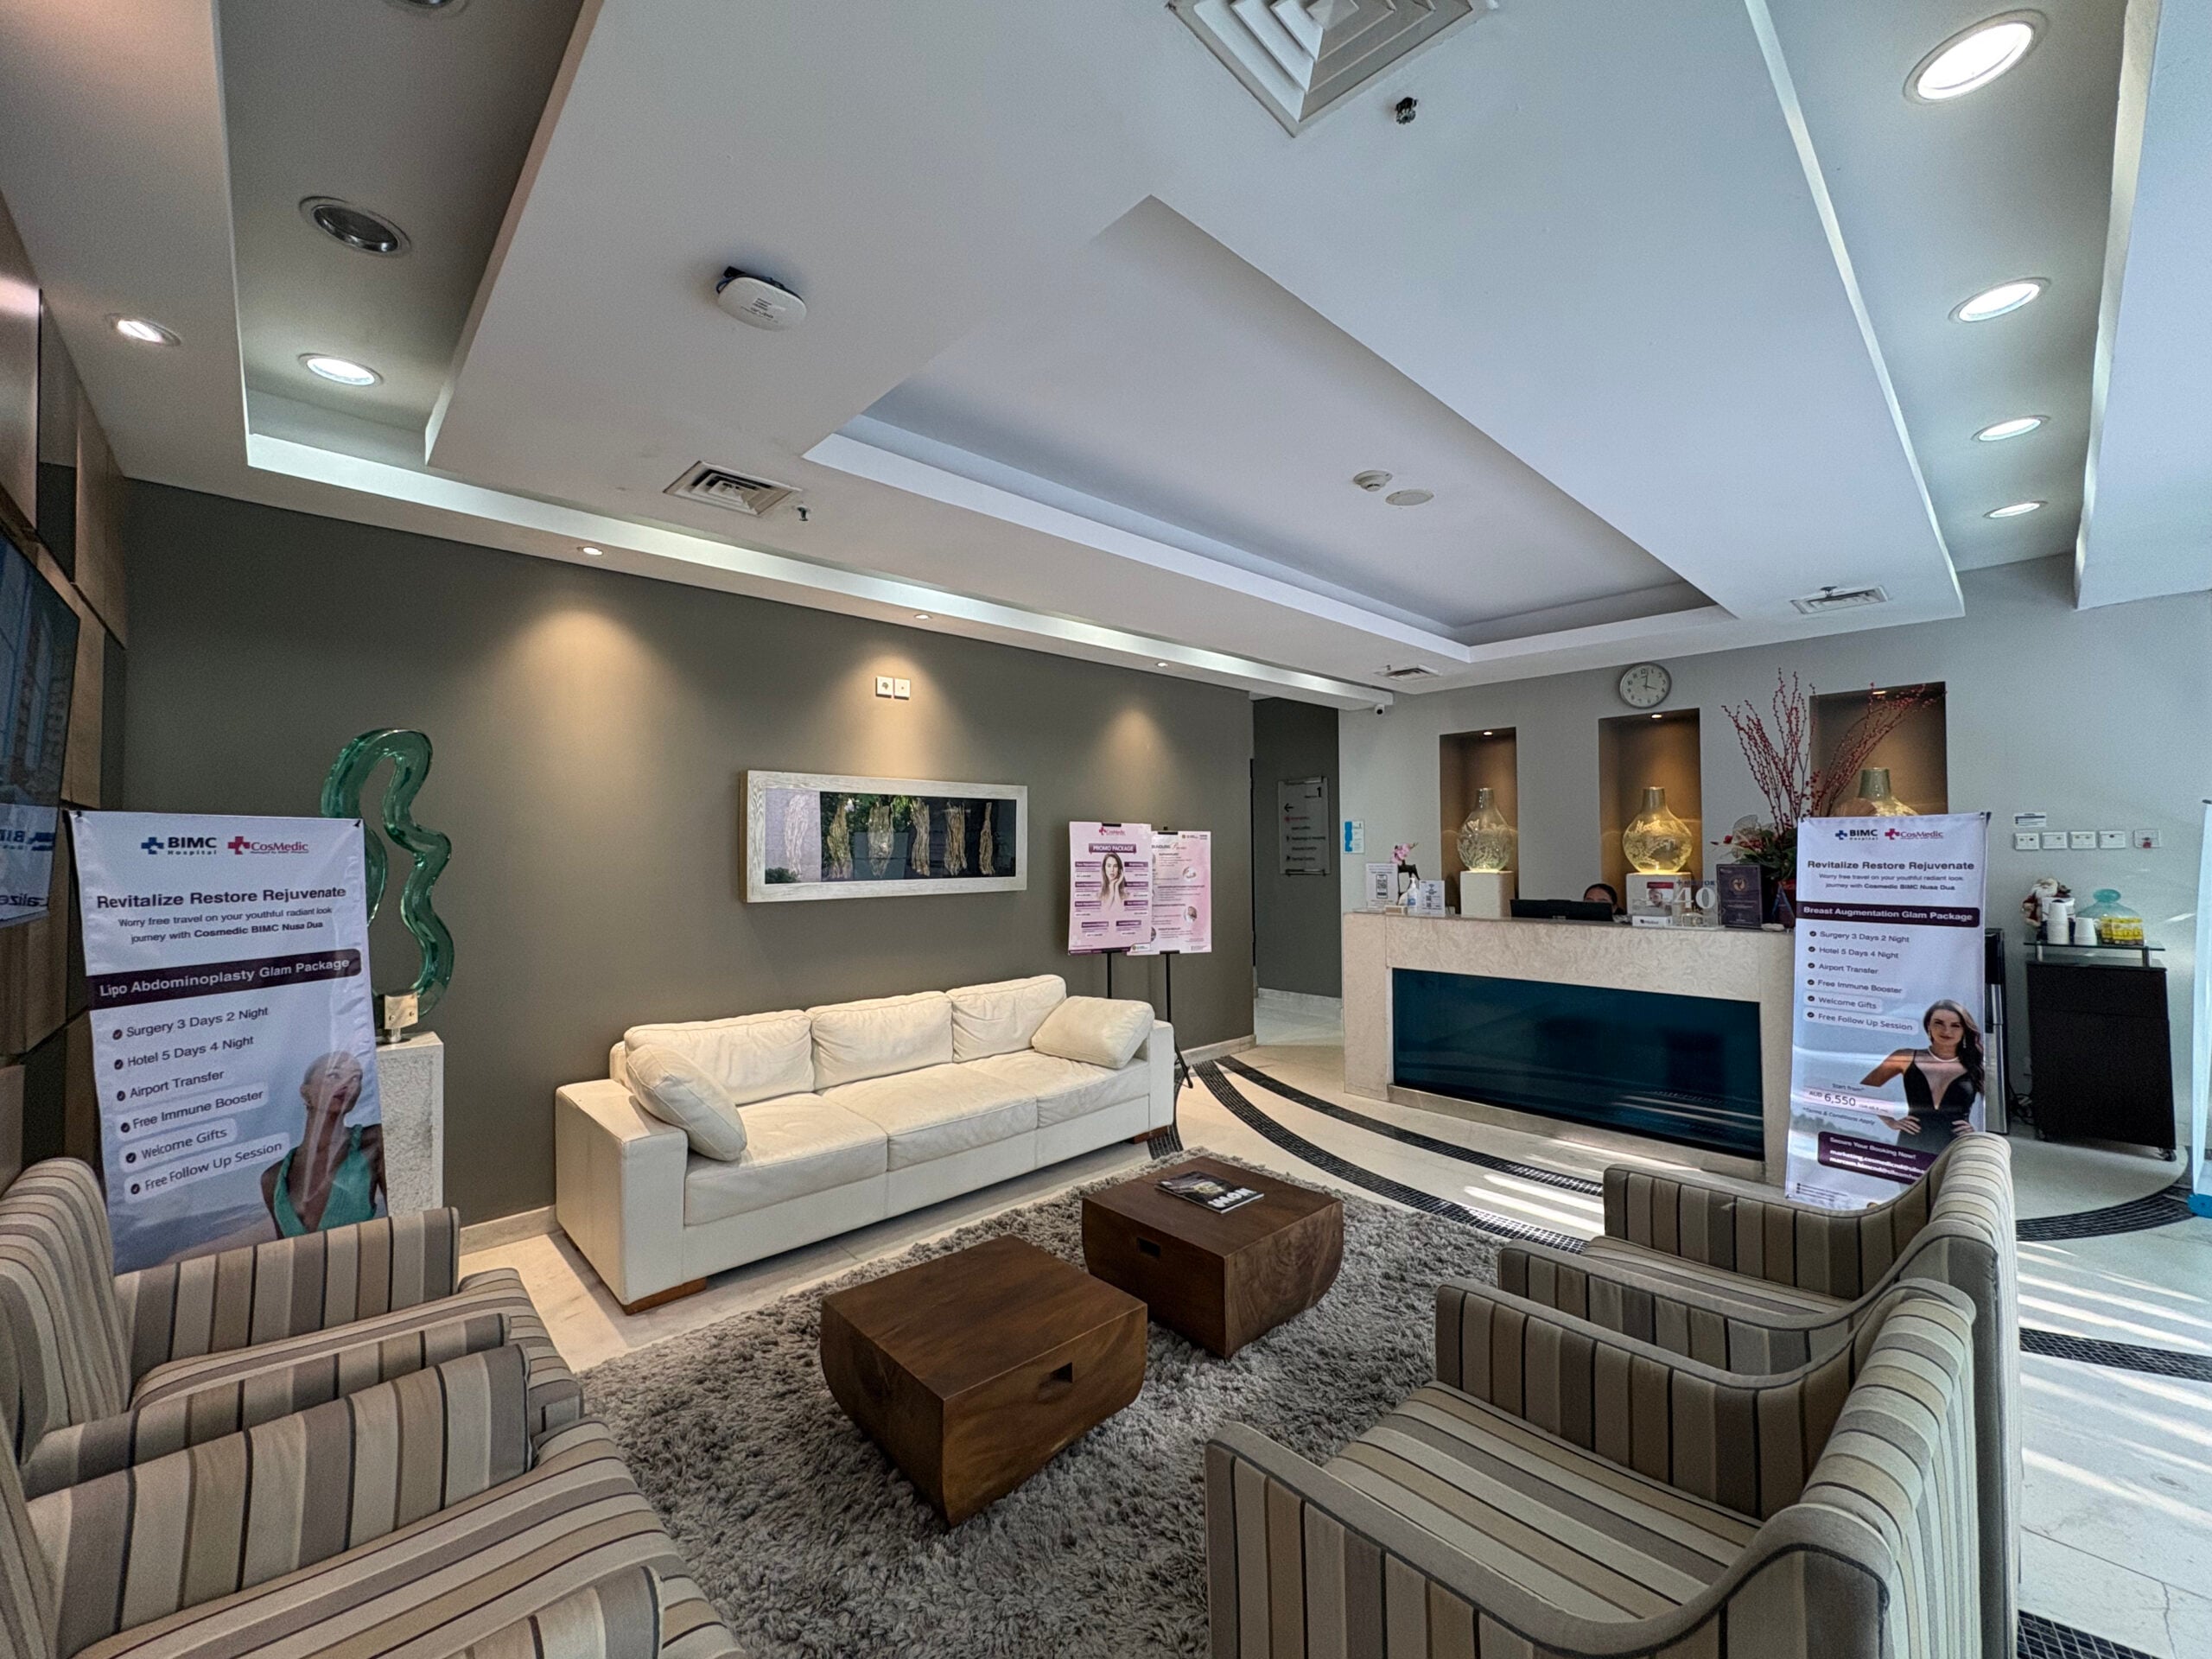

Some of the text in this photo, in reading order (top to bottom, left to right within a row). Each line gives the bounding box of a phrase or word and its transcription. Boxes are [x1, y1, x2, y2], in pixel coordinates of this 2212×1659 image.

[168, 836, 217, 849] BIMC
[1900, 830, 1943, 839] CosMedic
[251, 842, 308, 852] CosMedic
[1808, 861, 1974, 871] Revitalize Restore Rejuvenate
[97, 887, 346, 909] Revitalize Restore Rejuvenate
[1675, 887, 1716, 909] 40
[118, 918, 145, 929] Worry
[148, 915, 170, 925] free
[173, 913, 203, 924] travel
[221, 912, 244, 925] your
[245, 909, 283, 922] youthful
[285, 908, 315, 918] radiant
[316, 906, 332, 915] look
[1803, 906, 1973, 922] Breast Augmentation Glam Package
[130, 932, 166, 944] journey
[168, 930, 191, 939] with
[194, 926, 249, 938] Cosmedic
[251, 924, 279, 933] BIMC
[282, 922, 304, 931] Nusa
[1820, 931, 1850, 940] Surgery
[1859, 933, 1879, 942] Days
[1888, 935, 1910, 944] Night
[1848, 949, 1869, 957] Days
[1878, 951, 1899, 960] Night
[99, 957, 350, 998] Lipo Abdominoplasty Glam Package
[1818, 963, 1878, 975] Airport Transfer
[1817, 979, 1903, 994] Free Immune Booster
[1818, 997, 1877, 1009] Welcome Gifts
[126, 1007, 269, 1039] Surgery 3 Days 2 Night
[1818, 1013, 1913, 1031] Free Follow Up Session
[127, 1036, 254, 1067] Hotel 5 Days 4 Night
[130, 1069, 225, 1099] Airport Transfer
[1824, 1093, 1856, 1107] 6,550
[132, 1090, 264, 1129] Free Immune Booster
[142, 1127, 227, 1160] Welcome Gifts
[145, 1141, 283, 1192] Free Follow Up Session
